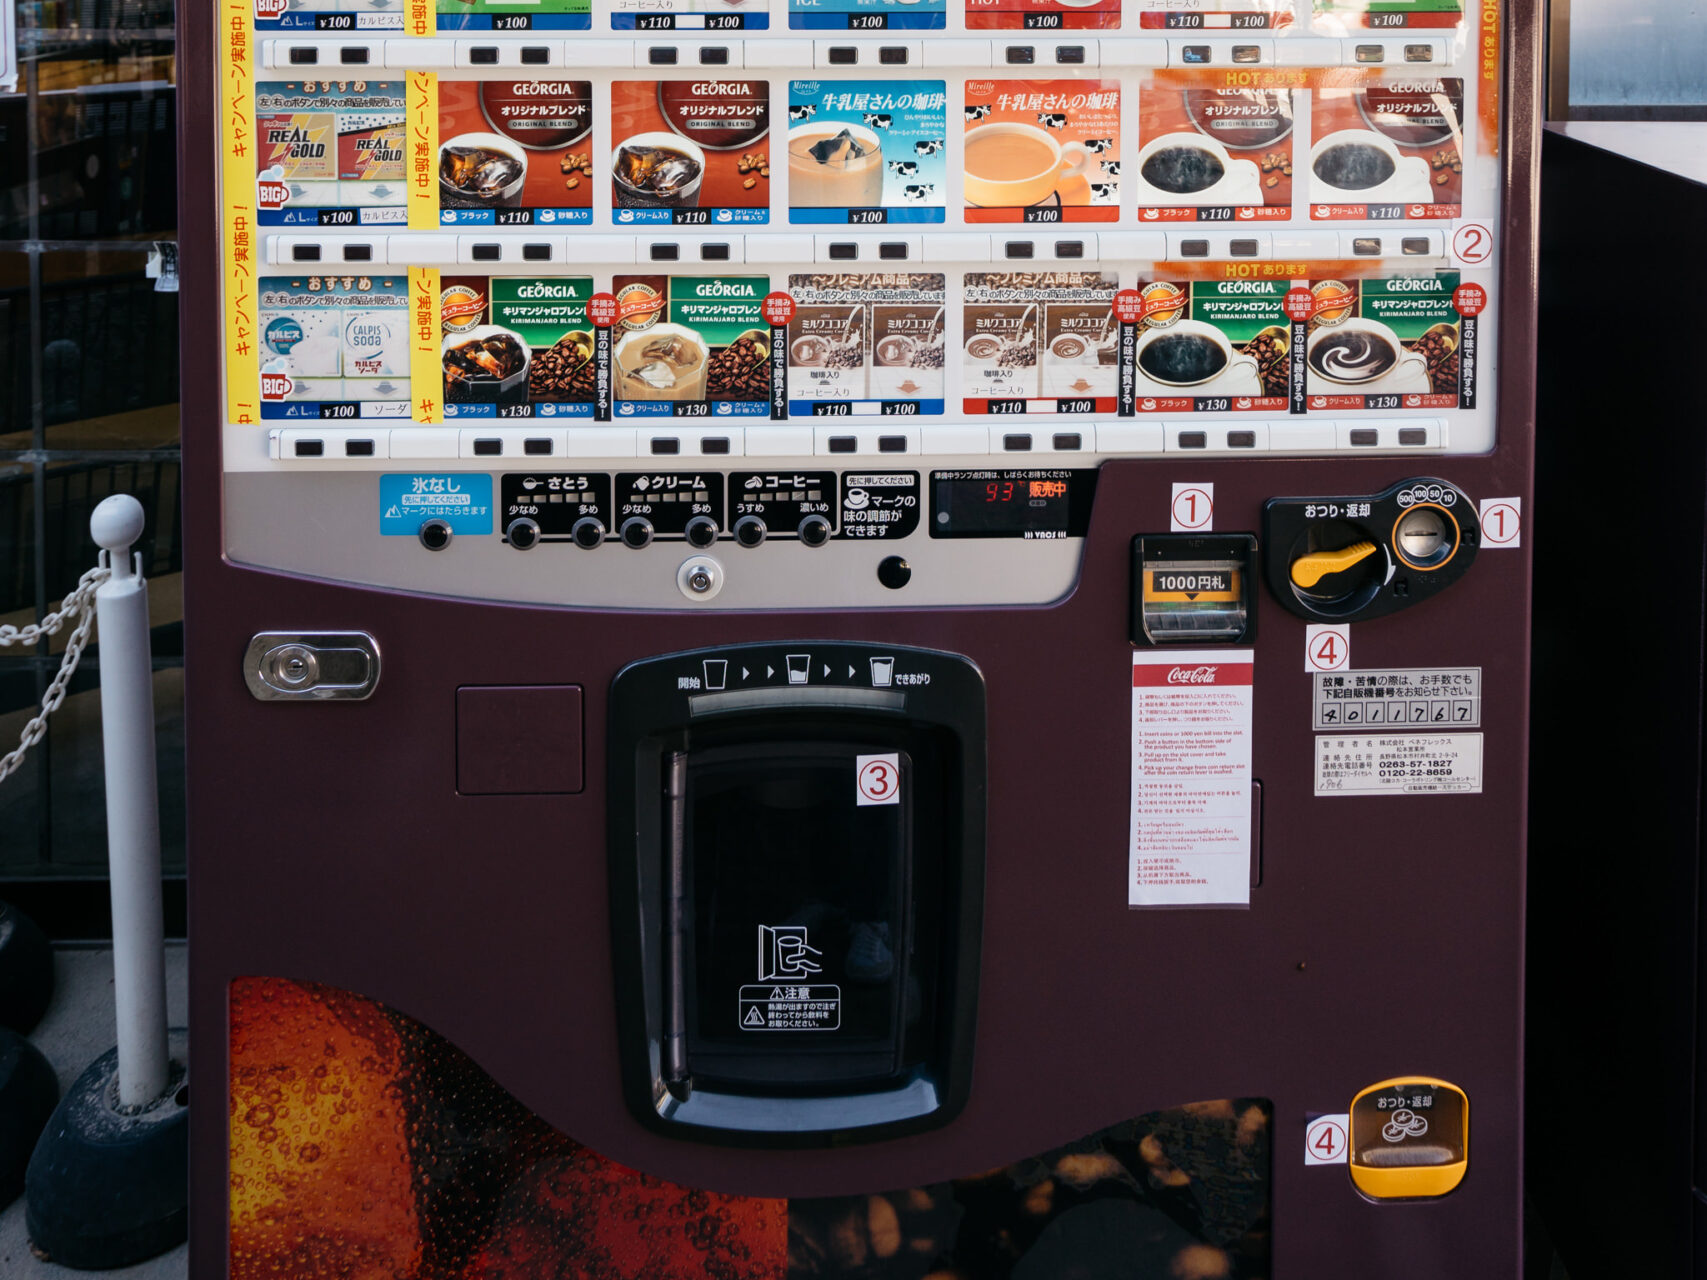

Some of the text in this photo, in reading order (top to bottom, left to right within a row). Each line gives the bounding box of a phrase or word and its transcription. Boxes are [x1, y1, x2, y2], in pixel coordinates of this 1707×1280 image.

[320, 15, 352, 29] ¥100
[496, 15, 528, 30] ¥100
[640, 15, 671, 29] ¥110
[709, 15, 740, 28] ¥100
[1169, 15, 1200, 28] ¥110
[513, 80, 573, 95] GEORGIA
[691, 80, 752, 96] GEORGIA
[821, 93, 947, 111] 牛乳屋さんの珈琲
[996, 93, 1119, 111] 牛乳屋さんの珈琲
[501, 104, 587, 117] オリジナルブレンド
[679, 105, 765, 116] オリジナルブレンド
[512, 120, 573, 128] ORIGINAL BLEND
[268, 125, 311, 144] REAL
[290, 143, 326, 158] GOLD
[460, 211, 489, 221] ブラック
[499, 210, 530, 224] ¥110
[635, 211, 669, 221] クリーム入り
[676, 210, 707, 224] ¥110
[1200, 208, 1231, 220] ¥110
[1371, 207, 1401, 218] ¥110
[517, 282, 579, 298] GEORGIA
[696, 280, 757, 296] GEORGIA
[1218, 280, 1277, 294] GEORGIA
[1386, 278, 1444, 292] GEORGIA
[510, 317, 558, 325] KIRIMANJARO
[802, 319, 849, 329] ミルクココア
[352, 325, 382, 336] CALPIS
[353, 334, 381, 346] soda
[991, 401, 1022, 414] ¥110
[1198, 399, 1228, 411] ¥130
[1368, 396, 1398, 408] ¥130
[500, 404, 531, 418] ¥130
[677, 403, 708, 417] ¥130
[816, 403, 848, 416] ¥110
[412, 477, 461, 493] 氷なし
[548, 476, 589, 490] さとう
[652, 476, 706, 489] クリーム
[765, 476, 821, 487] コーヒー
[985, 482, 1014, 502] 93
[1029, 480, 1067, 498] 販売中
[404, 495, 469, 505] 先に押してください
[871, 495, 916, 507] マークの
[400, 505, 488, 516] マークにはたらきます
[508, 504, 598, 515] 少なめ 多め
[736, 502, 829, 513] うすめ 濃いめ
[1304, 504, 1371, 518] おつり・返却
[843, 510, 902, 522] 味の調節が
[844, 524, 889, 536] できます
[1159, 576, 1225, 590] 1000円札
[895, 673, 931, 685] できあがり
[1167, 666, 1218, 684] Coca-Cola
[1322, 673, 1473, 688] 故障・苦情の際は、お手数でも
[678, 677, 700, 689] 開始
[1322, 687, 1473, 699] 下記自販機番号をお知らせ下さい。
[1379, 760, 1453, 768] 0263-57-1827
[785, 987, 810, 1000] 注意
